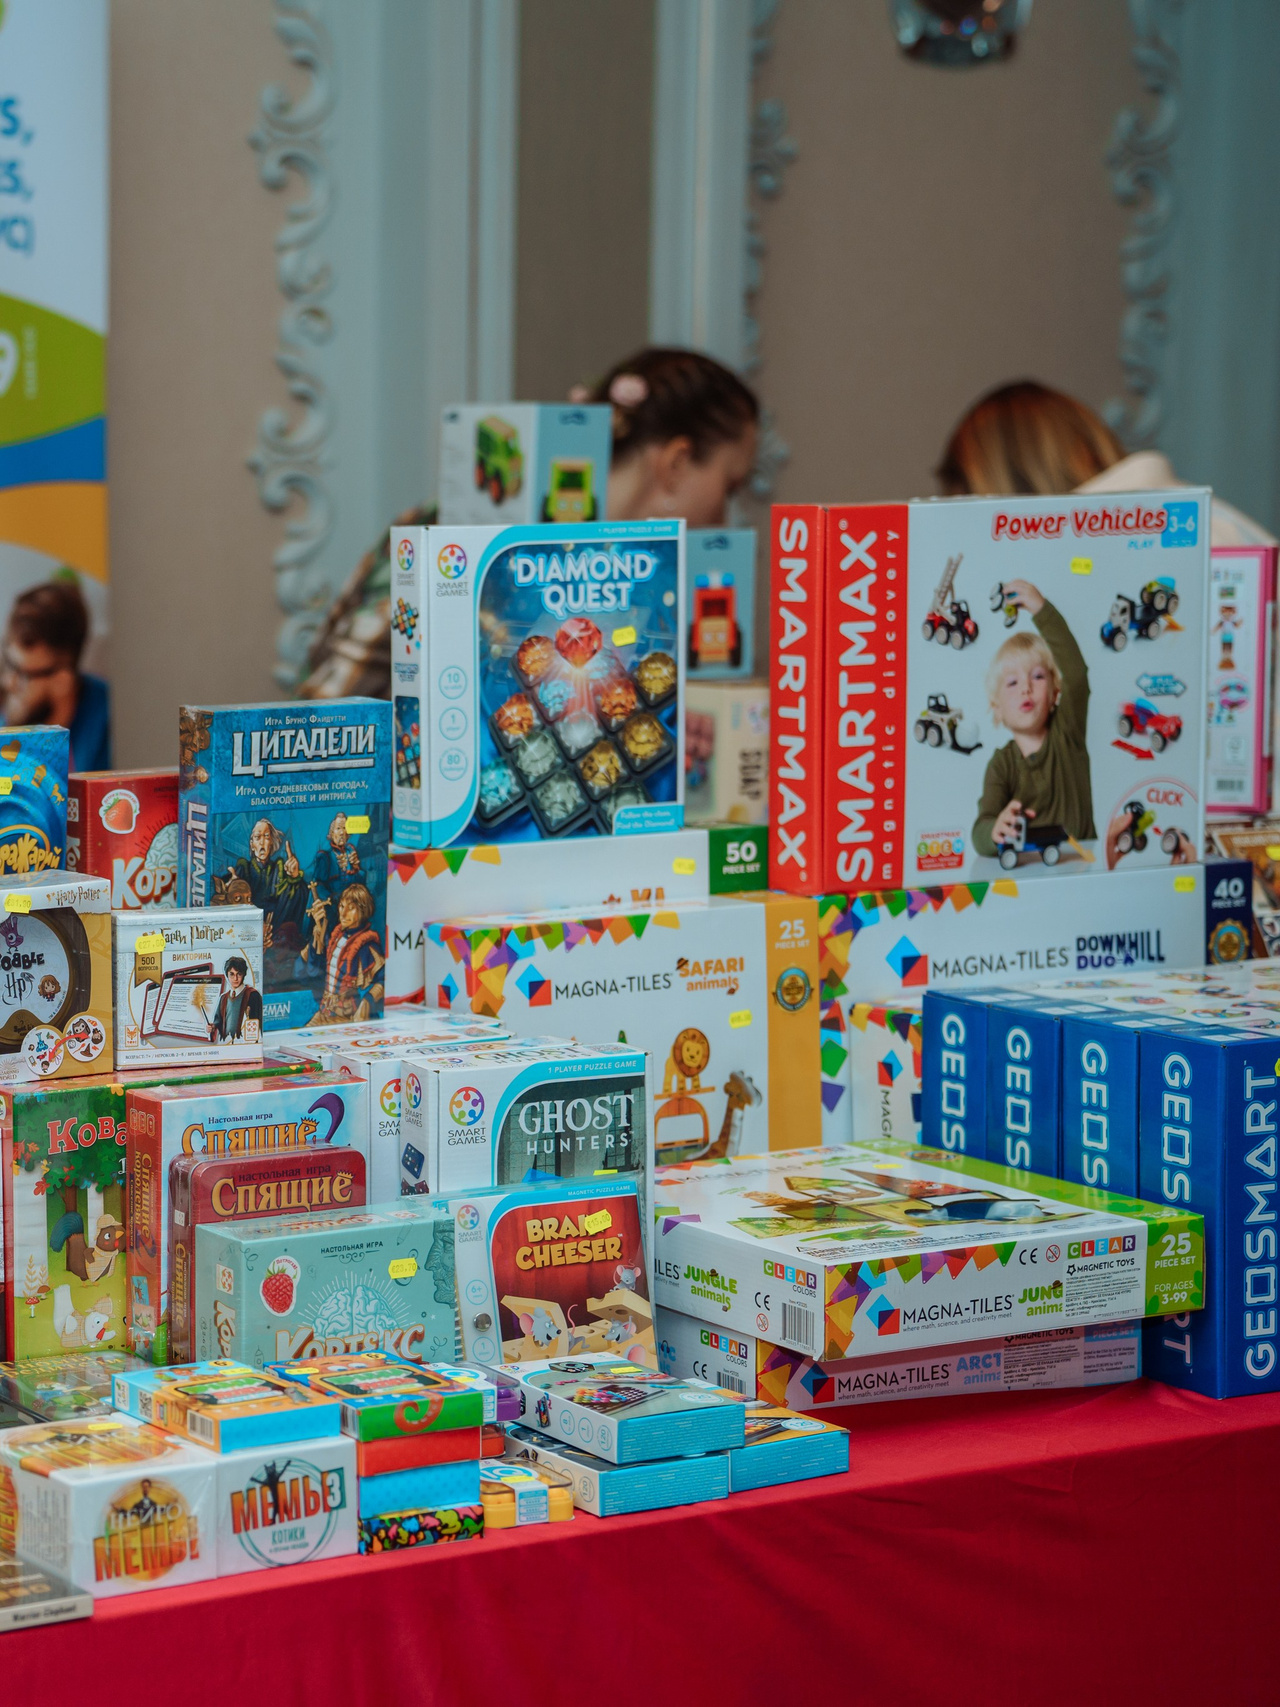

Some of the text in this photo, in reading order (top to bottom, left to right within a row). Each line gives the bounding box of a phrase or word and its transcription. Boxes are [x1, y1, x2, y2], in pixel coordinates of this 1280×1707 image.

[994, 505, 1166, 537] Power Vehicles
[516, 554, 654, 584] DIAMOND
[435, 589, 469, 597] GAMES
[436, 582, 469, 590] SMART
[544, 583, 632, 616] QUEST
[777, 518, 809, 868] SMARTMAX
[837, 530, 878, 882] SMARTMAX
[882, 530, 901, 880] magnetic discovery
[231, 724, 376, 778] ЦИТАДЕЛИ
[1145, 788, 1185, 806] CLICK
[726, 841, 757, 862] 50
[722, 862, 760, 875] PIECE SET
[1214, 877, 1245, 899] 40
[779, 920, 806, 940] 25
[172, 953, 212, 962] ВИКТОРИНА
[1076, 930, 1166, 963] DOWNHILL
[141, 956, 155, 965] 500
[678, 957, 745, 978] SAFARI
[932, 947, 1069, 980] MAGNA-TILES
[1076, 953, 1116, 970] DUO
[555, 973, 672, 1000] MAGNA-TILES
[686, 976, 740, 995] animals
[554, 1060, 637, 1074] PLAYER PUZZLE GAME
[941, 1012, 967, 1152] GEOS
[1005, 1026, 1032, 1169] GEOS
[208, 1112, 273, 1125] Настольная игра
[519, 1094, 635, 1135] GHOST
[1081, 1041, 1109, 1186] GEOS
[182, 1116, 318, 1154] Спящие
[447, 1136, 487, 1146] GAMES
[448, 1127, 486, 1138] SMART
[526, 1132, 629, 1155] HUNTERS
[238, 1163, 331, 1182] настольная игра
[141, 1152, 152, 1239] Спящие
[211, 1169, 354, 1216] Спящие
[568, 1188, 594, 1196] MAGNETIC
[595, 1186, 615, 1194] PUZZLE
[526, 1213, 600, 1243] BRAI
[1244, 1068, 1277, 1379] GEOSMART
[321, 1241, 384, 1254] НАСТОЛЬНАЯ ИГРА
[515, 1237, 622, 1271] CHEESER
[1068, 1236, 1136, 1258] CLEAR
[1161, 1232, 1192, 1257] 25
[1077, 1258, 1135, 1273] MAGNETIC TOYS
[1154, 1256, 1196, 1269] PIECE SET
[684, 1265, 738, 1295] JUNGLE
[764, 1260, 816, 1289] CLEAR
[792, 1284, 817, 1299] COLORS
[1154, 1280, 1194, 1293] FOR AGES
[691, 1284, 732, 1312] animals
[1161, 1291, 1188, 1305] 3-99
[902, 1295, 1013, 1325] MAGNA-TILES
[921, 1322, 936, 1330] math,
[972, 1313, 997, 1323] creativity
[701, 1330, 747, 1359] CLEAR
[725, 1355, 748, 1368] COLORS
[838, 1363, 950, 1394] MAGNA-TILES
[856, 1391, 871, 1399] math,
[271, 1526, 306, 1546] КОТИКИ
